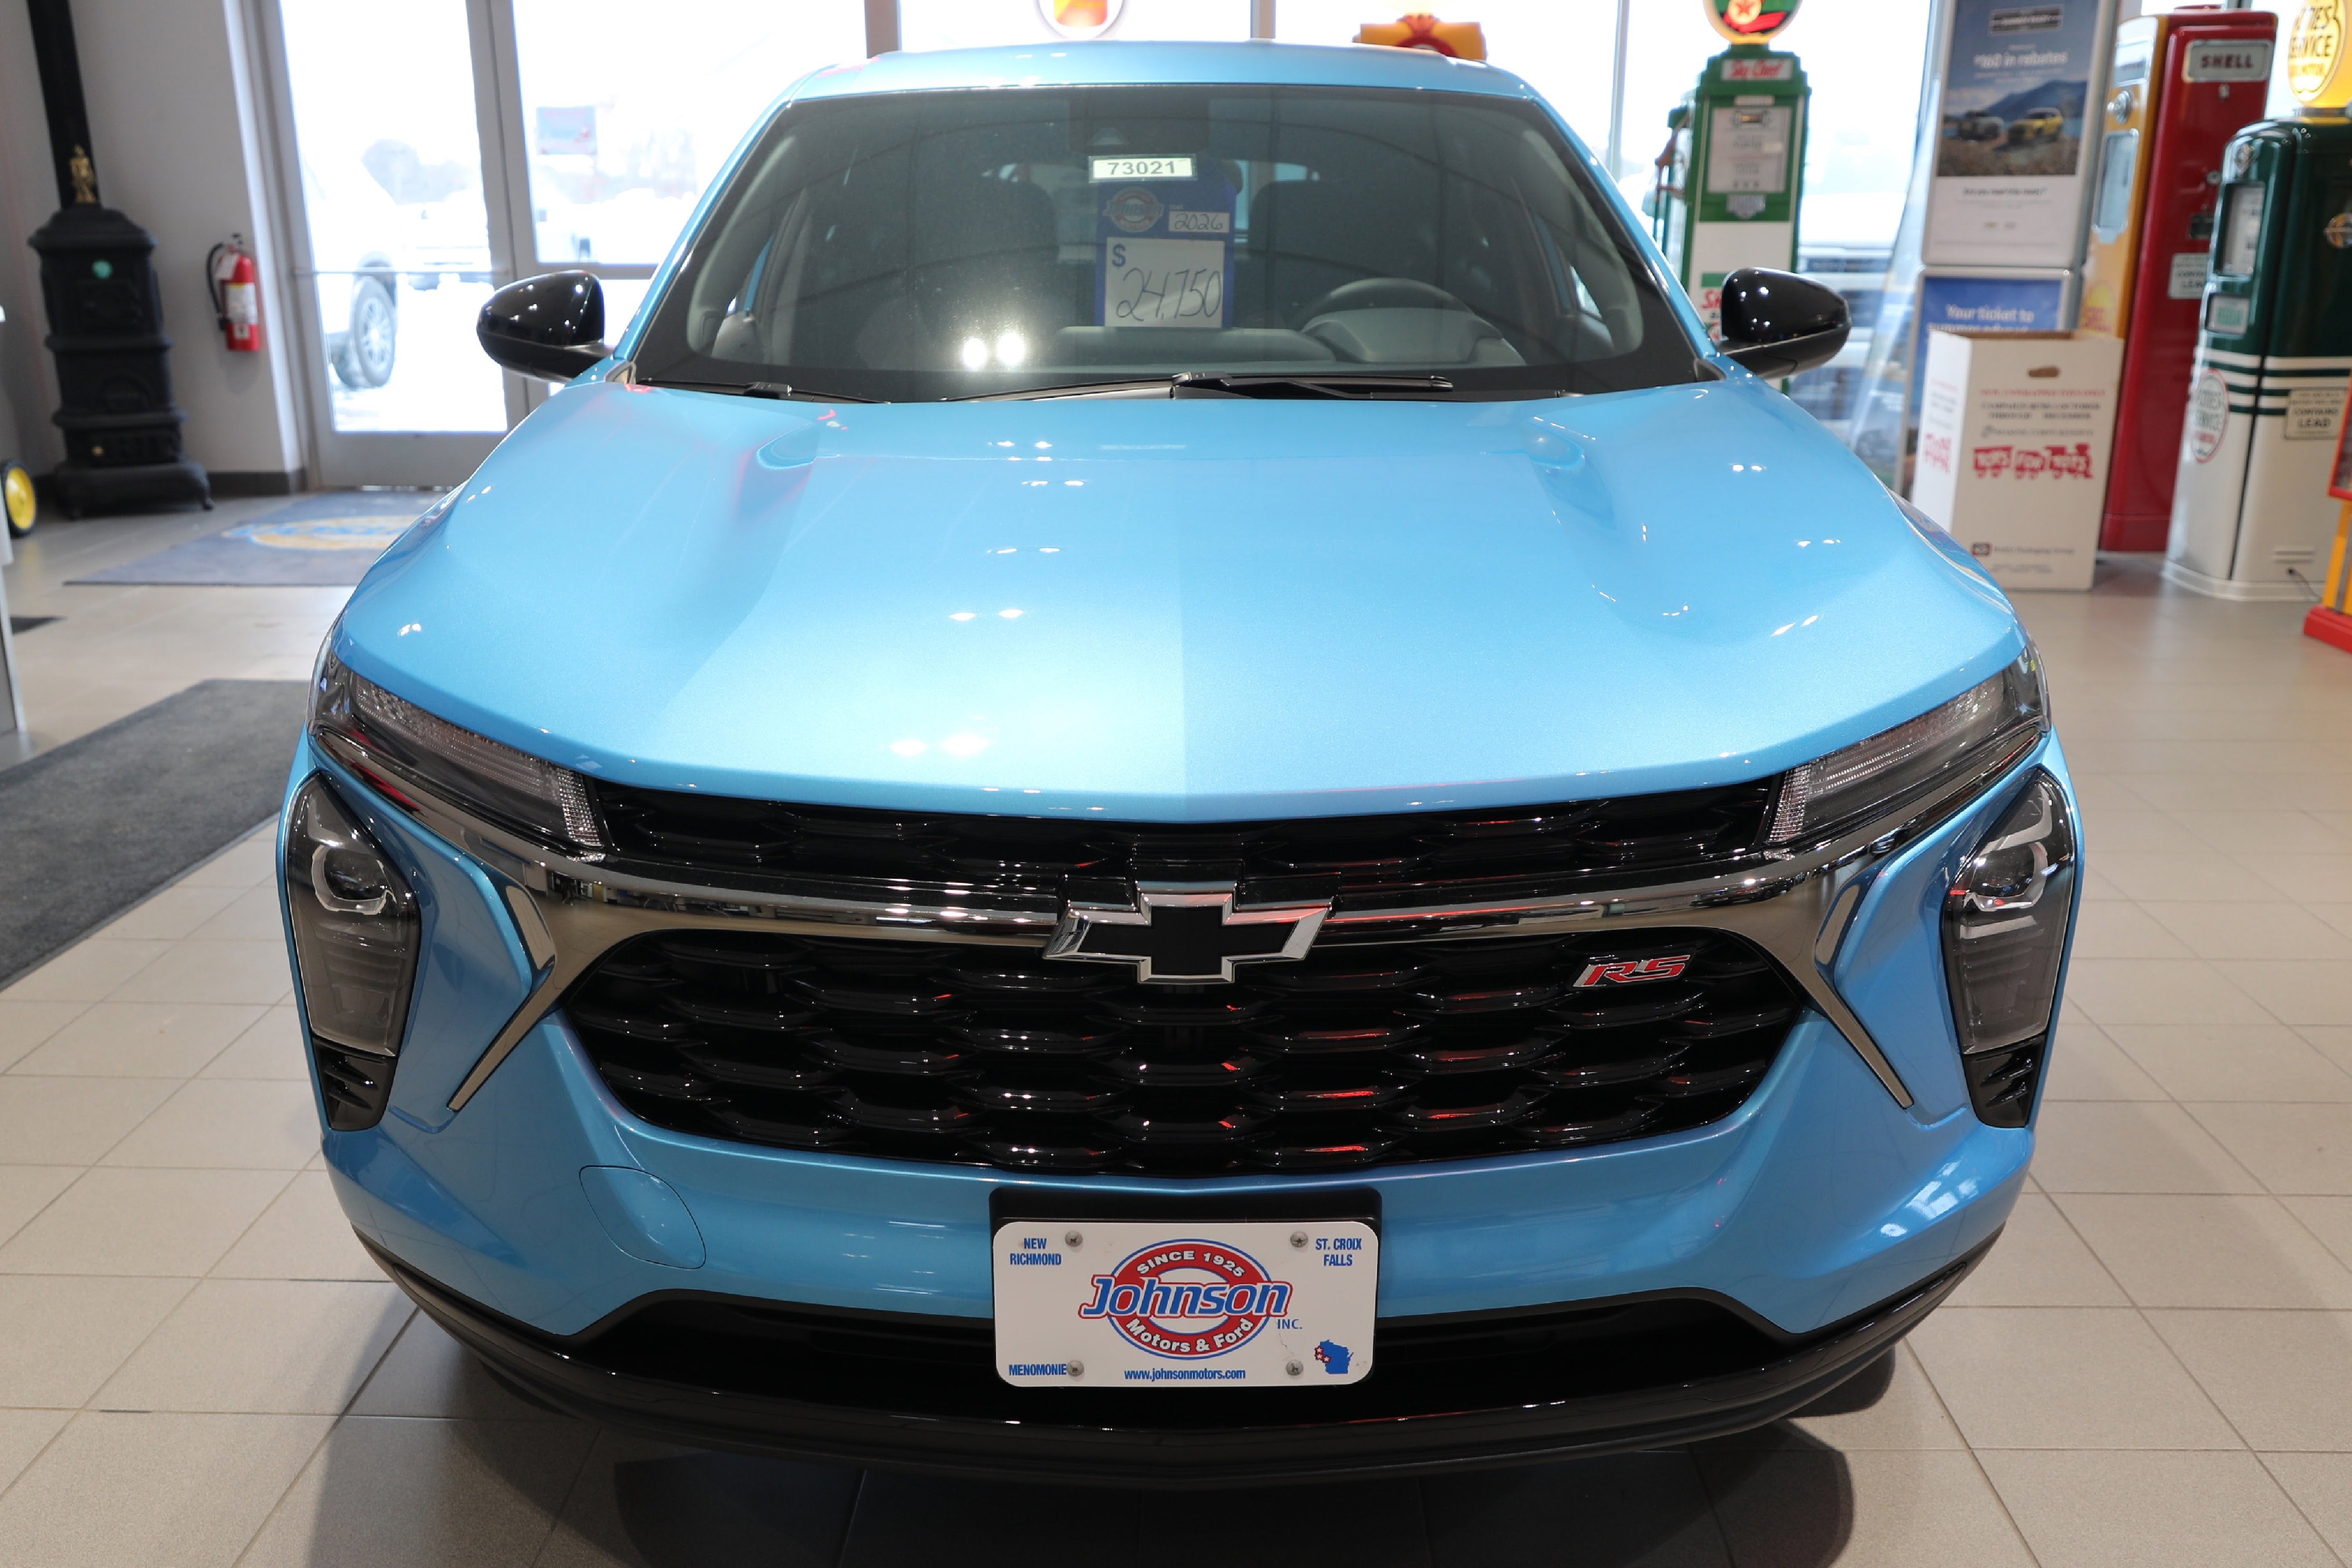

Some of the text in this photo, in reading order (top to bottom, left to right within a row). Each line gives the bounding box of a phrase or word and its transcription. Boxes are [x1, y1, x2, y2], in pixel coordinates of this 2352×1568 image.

[2201, 54, 2253, 68] SHELL
[1108, 160, 1175, 175] 73021
[1174, 212, 1223, 230] 2026
[1112, 243, 1126, 268] $
[1946, 303, 2034, 323] Your ticket to
[2297, 418, 2331, 427] LEAD
[1573, 954, 1691, 987] RS
[1023, 1238, 1047, 1249] NEW
[1315, 1238, 1362, 1250] ST. CROIX
[1010, 1253, 1062, 1265] RICHMOND
[1136, 1250, 1246, 1278] SINCE 1925
[1324, 1254, 1353, 1266] FALLS
[1080, 1276, 1292, 1317] Johnson
[1277, 1319, 1303, 1330] INC.
[1125, 1317, 1255, 1353] Motors & Ford
[1008, 1364, 1067, 1376] MENOMONIE
[1123, 1368, 1246, 1382] www.johnsonmotors.com
